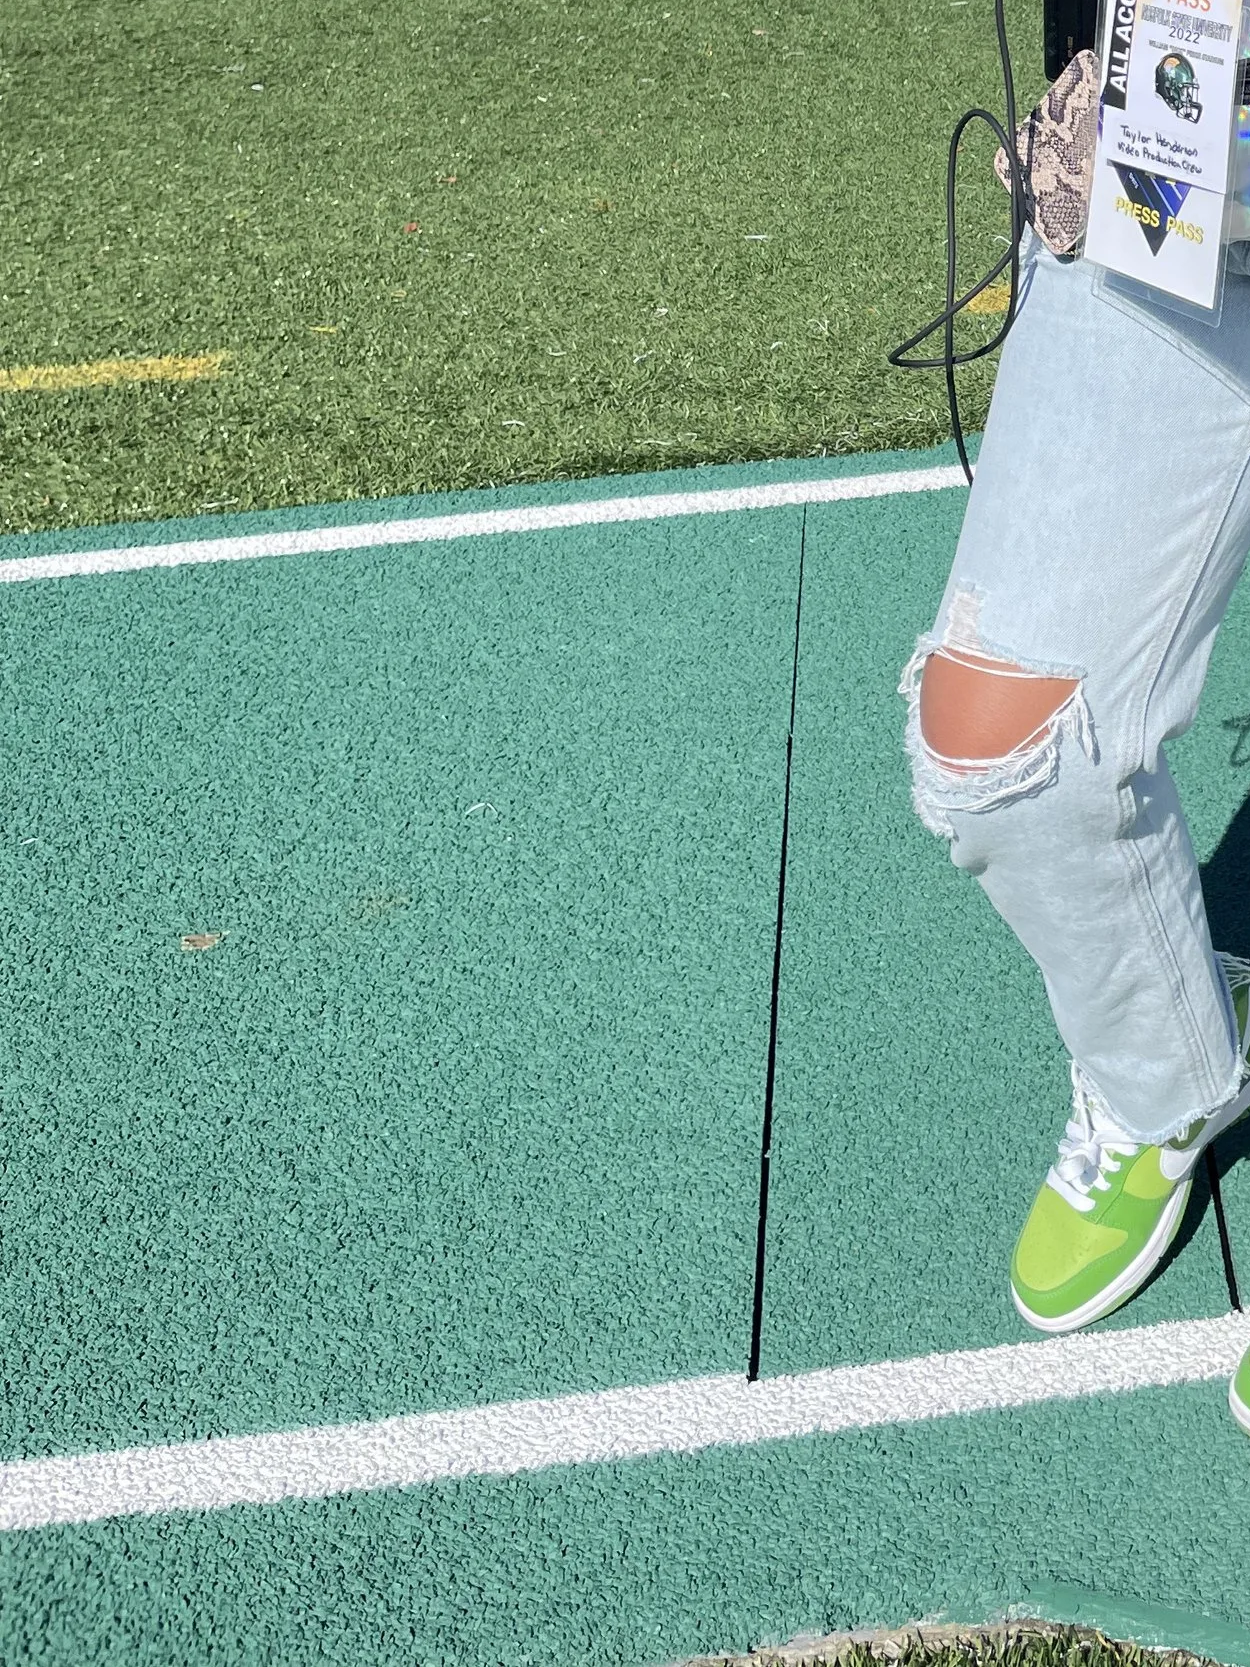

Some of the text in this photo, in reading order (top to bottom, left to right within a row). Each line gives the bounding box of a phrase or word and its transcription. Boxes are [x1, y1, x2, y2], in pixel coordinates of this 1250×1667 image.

[1168, 25, 1201, 45] 2022
[1192, 16, 1234, 43] UNIVERSITY
[1110, 47, 1130, 94] ALL
[1120, 124, 1152, 144] Taylor
[1117, 141, 1203, 174] Video Production Crew
[1115, 196, 1205, 244] PRESS PASS
